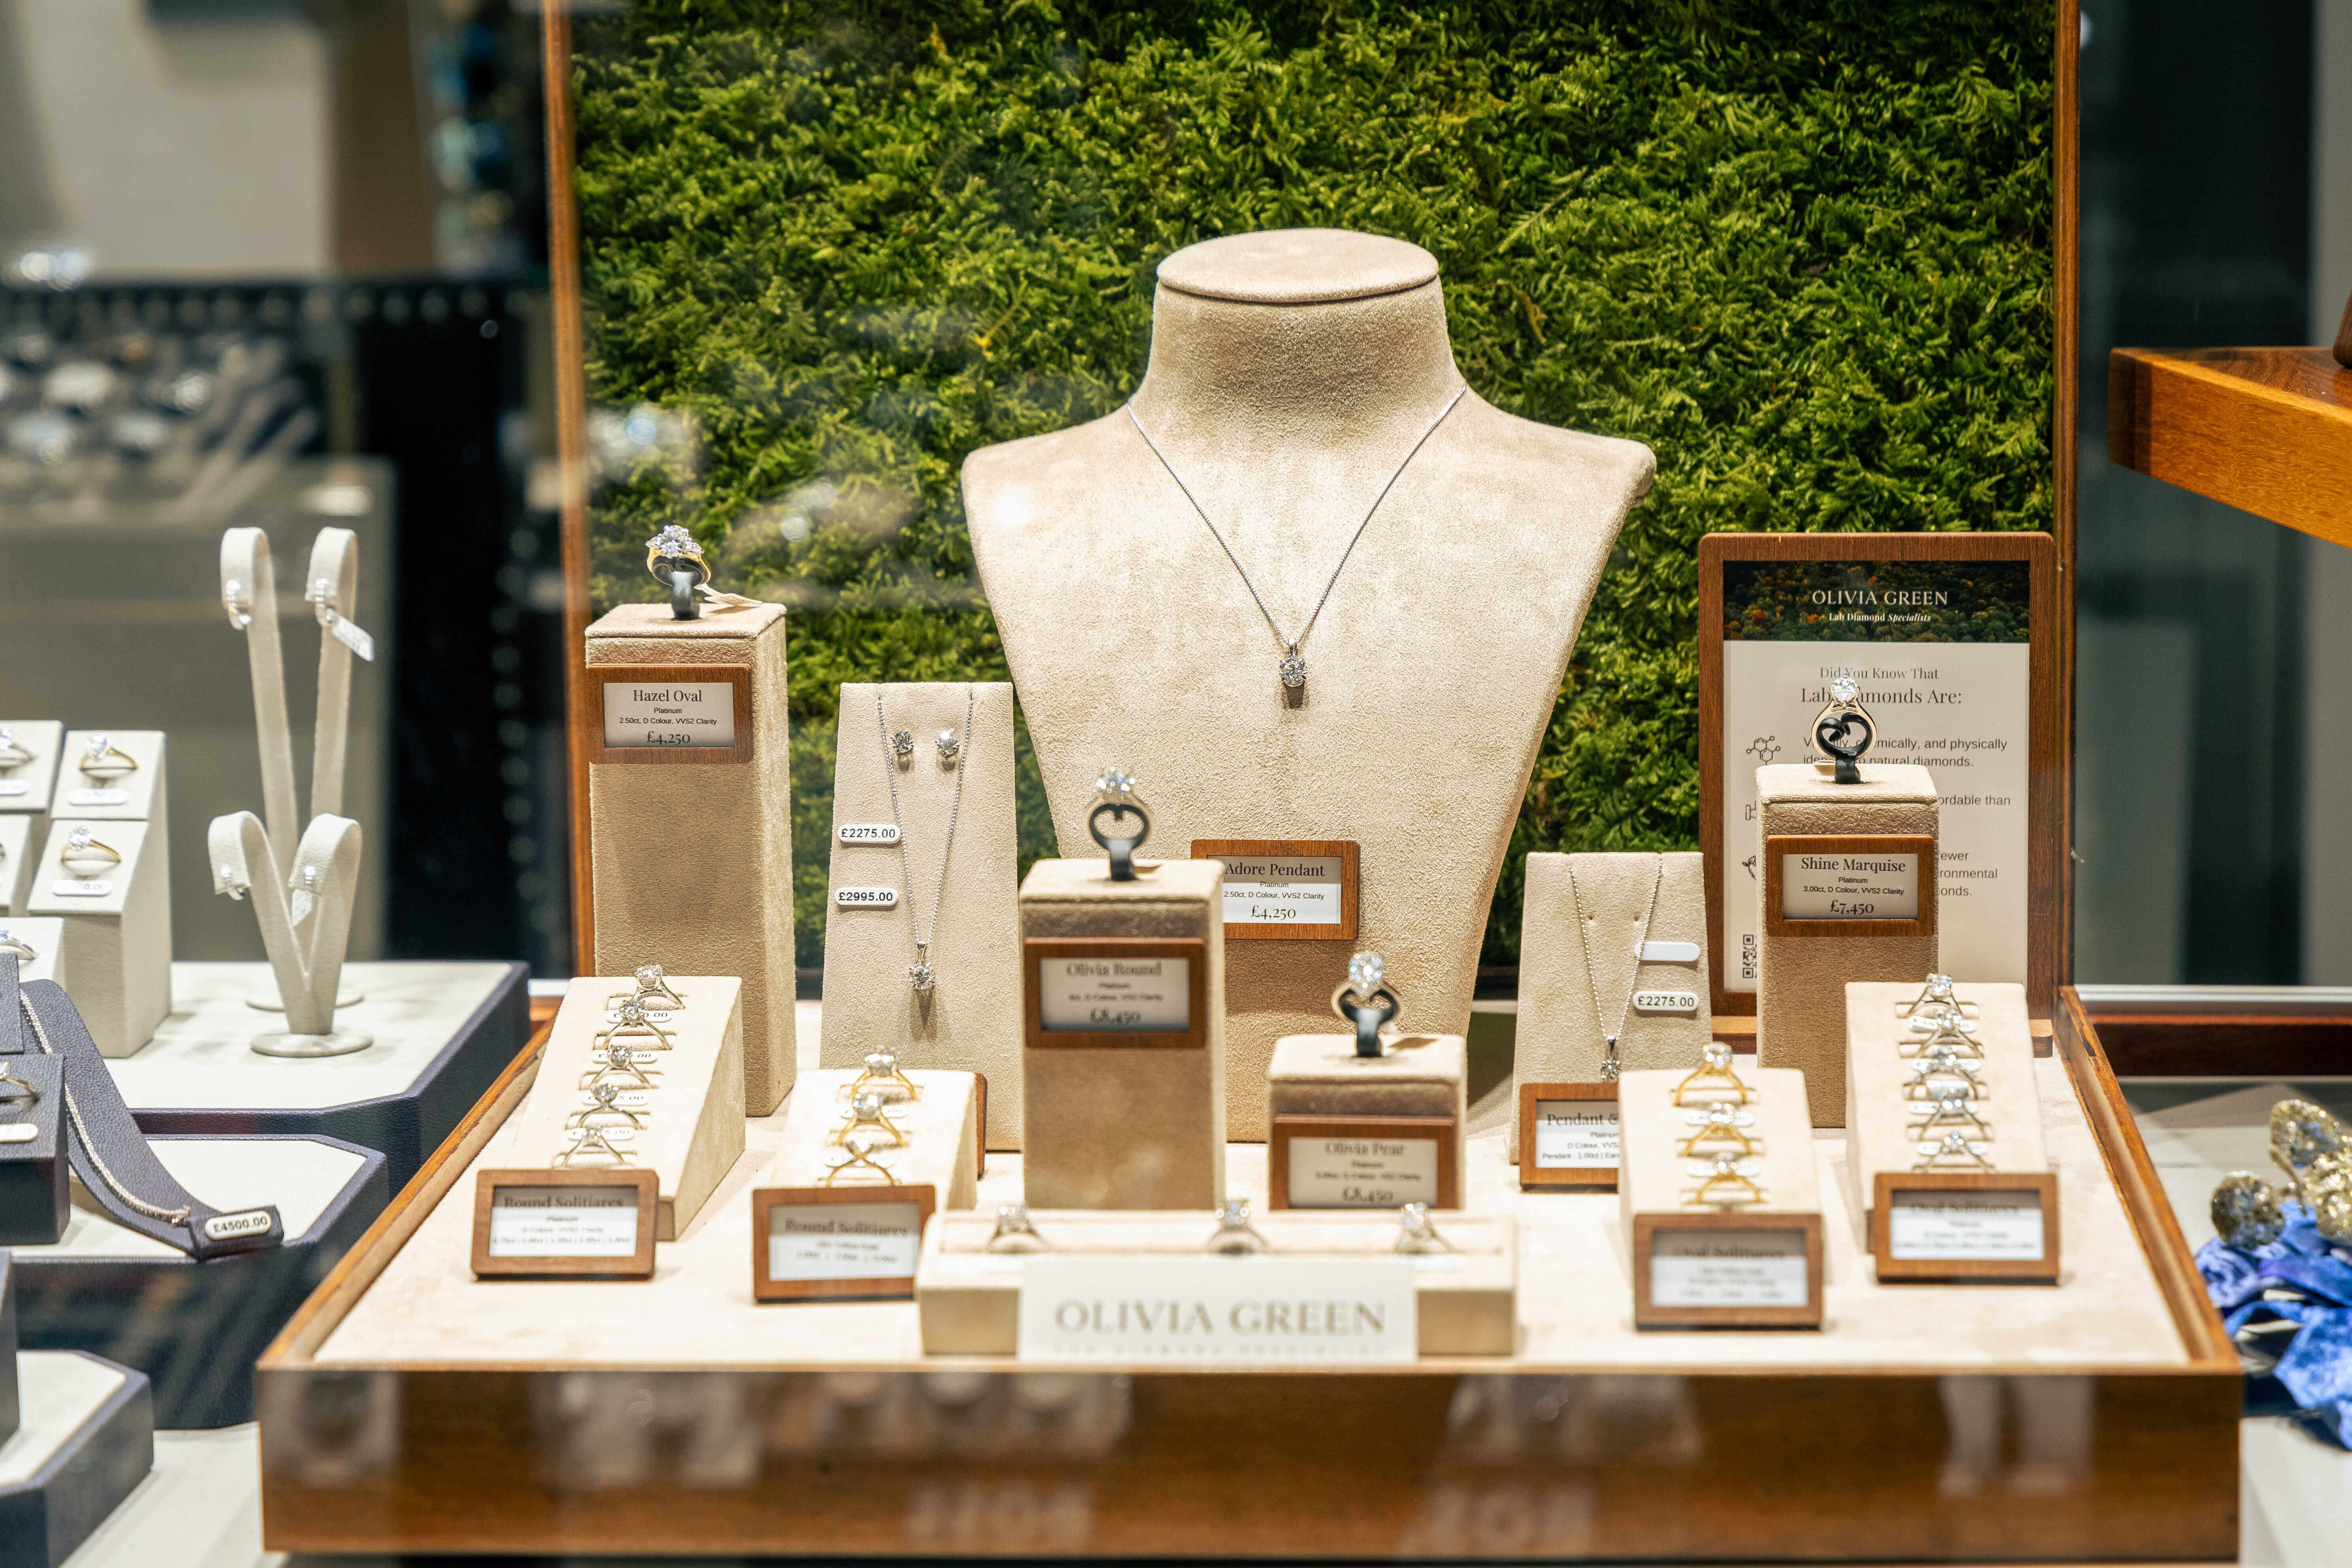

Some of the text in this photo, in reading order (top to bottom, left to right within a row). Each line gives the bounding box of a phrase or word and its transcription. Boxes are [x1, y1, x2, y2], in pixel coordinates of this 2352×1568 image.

[1812, 590, 1948, 605] OLIVIA GREEN
[1829, 613, 1931, 623] Lab Diamond Specialists
[1820, 667, 1939, 679] Did You Know That
[633, 689, 702, 702] Hazel Oval
[1801, 688, 1962, 704] Lab amonds Are:
[647, 730, 690, 745] £4,250
[1924, 737, 1946, 748] and
[1951, 738, 2007, 751] physically
[1870, 755, 1909, 764] natural
[1913, 757, 1973, 766] diamonds.
[1938, 795, 2011, 806] ordable than
[841, 828, 895, 838] £2275.00
[1225, 862, 1325, 877] Adore Pendant
[1801, 857, 1906, 873] Shine Marquise
[1940, 869, 1998, 879] ronmental
[838, 892, 893, 901] £2995.00
[1883, 888, 1904, 896] Clarity
[1938, 886, 1972, 896] onds.
[1251, 904, 1296, 920] £4,250
[1830, 900, 1874, 915] £7,450
[1638, 996, 1694, 1007] £2275.00
[1547, 1112, 1604, 1126] Pendant
[504, 1195, 551, 1208] Round
[213, 1216, 268, 1233] £4500.00
[1054, 1298, 1385, 1337] OLIVIA GREEN
